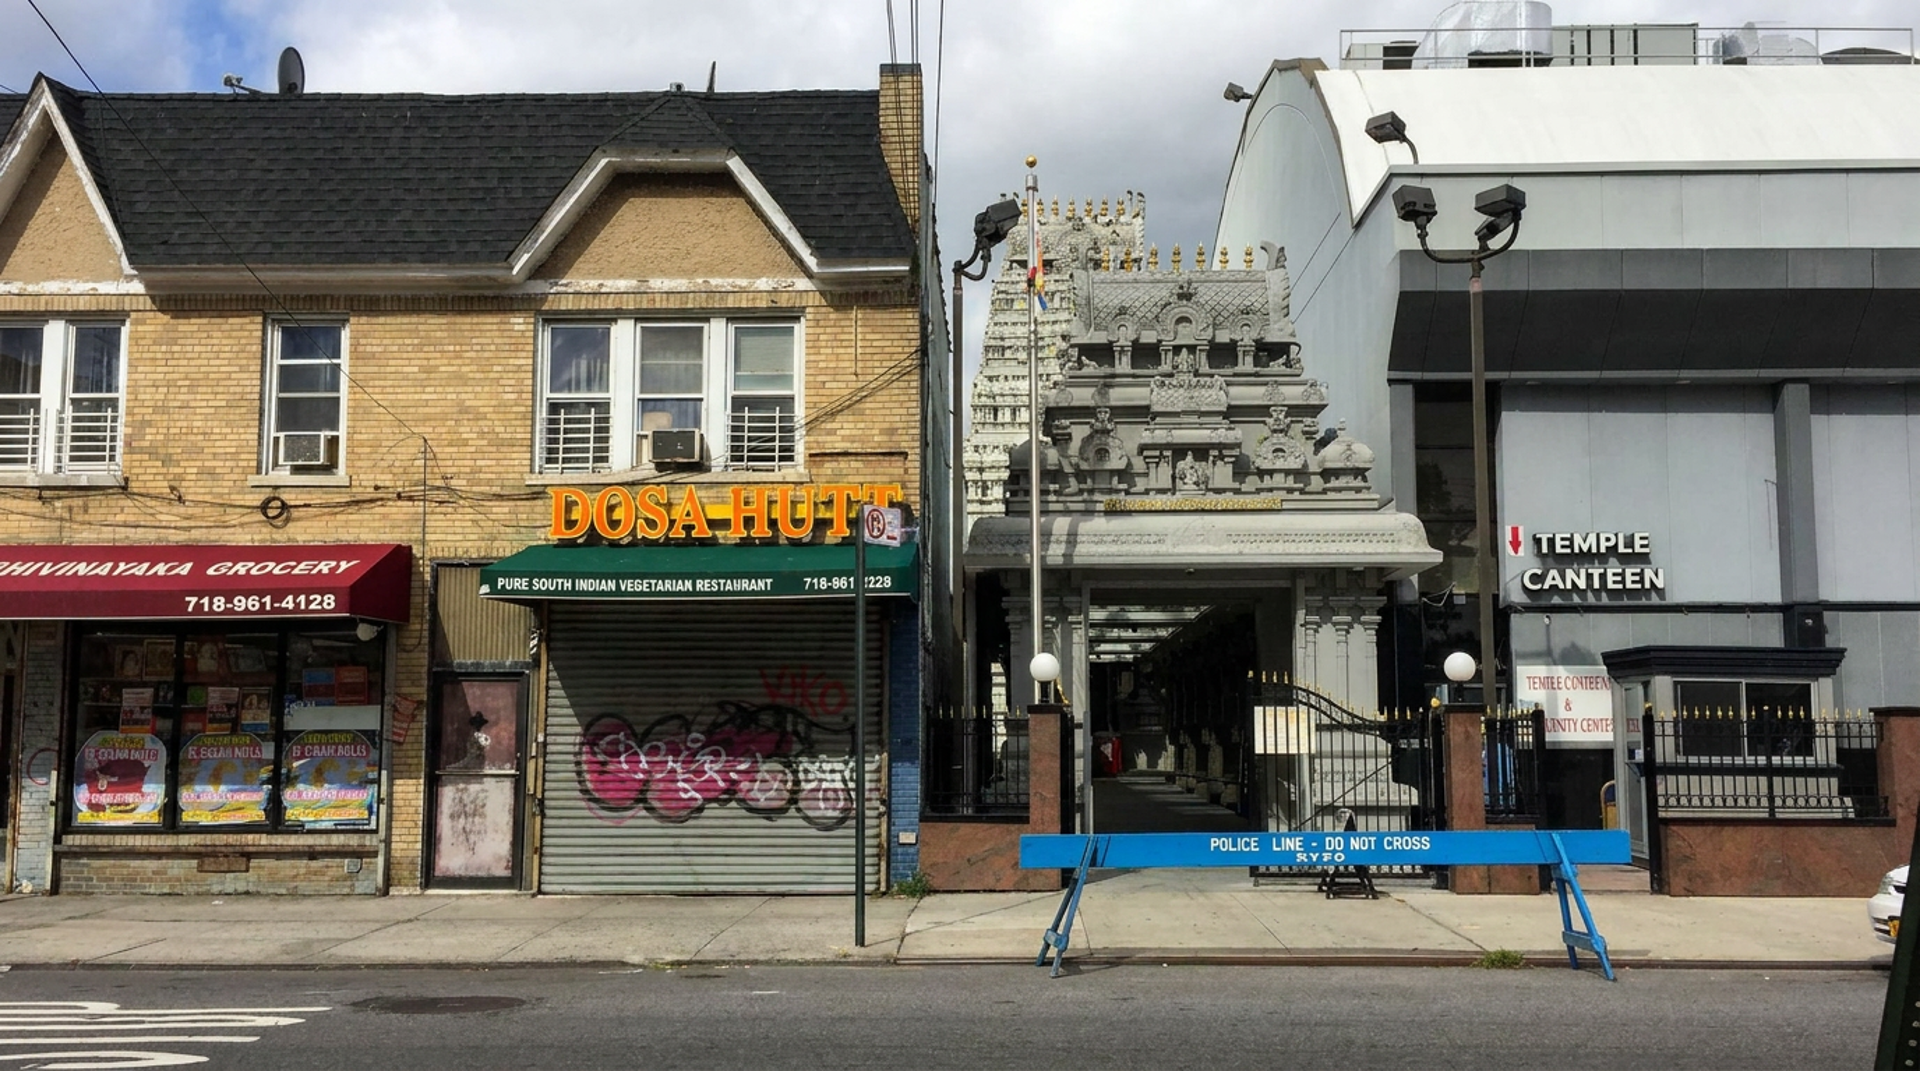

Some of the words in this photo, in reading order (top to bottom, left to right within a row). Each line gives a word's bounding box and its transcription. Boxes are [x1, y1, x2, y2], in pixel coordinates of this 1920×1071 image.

[549, 485, 712, 539] DOSA
[1535, 532, 1651, 554] TEMPLE
[206, 560, 361, 576] GROCERY
[497, 577, 530, 591] PURE
[532, 578, 572, 592] SOUTH
[575, 579, 616, 592] INDIAN
[618, 579, 693, 593] VEGETARIAN
[1523, 568, 1665, 590] CANTEEN
[185, 593, 336, 612] 718-961-4128
[1210, 837, 1259, 852] POLICE
[1272, 837, 1304, 851] LINE
[1325, 837, 1344, 850] DO
[1350, 837, 1377, 850] NOT
[1383, 836, 1431, 850] CROSS
